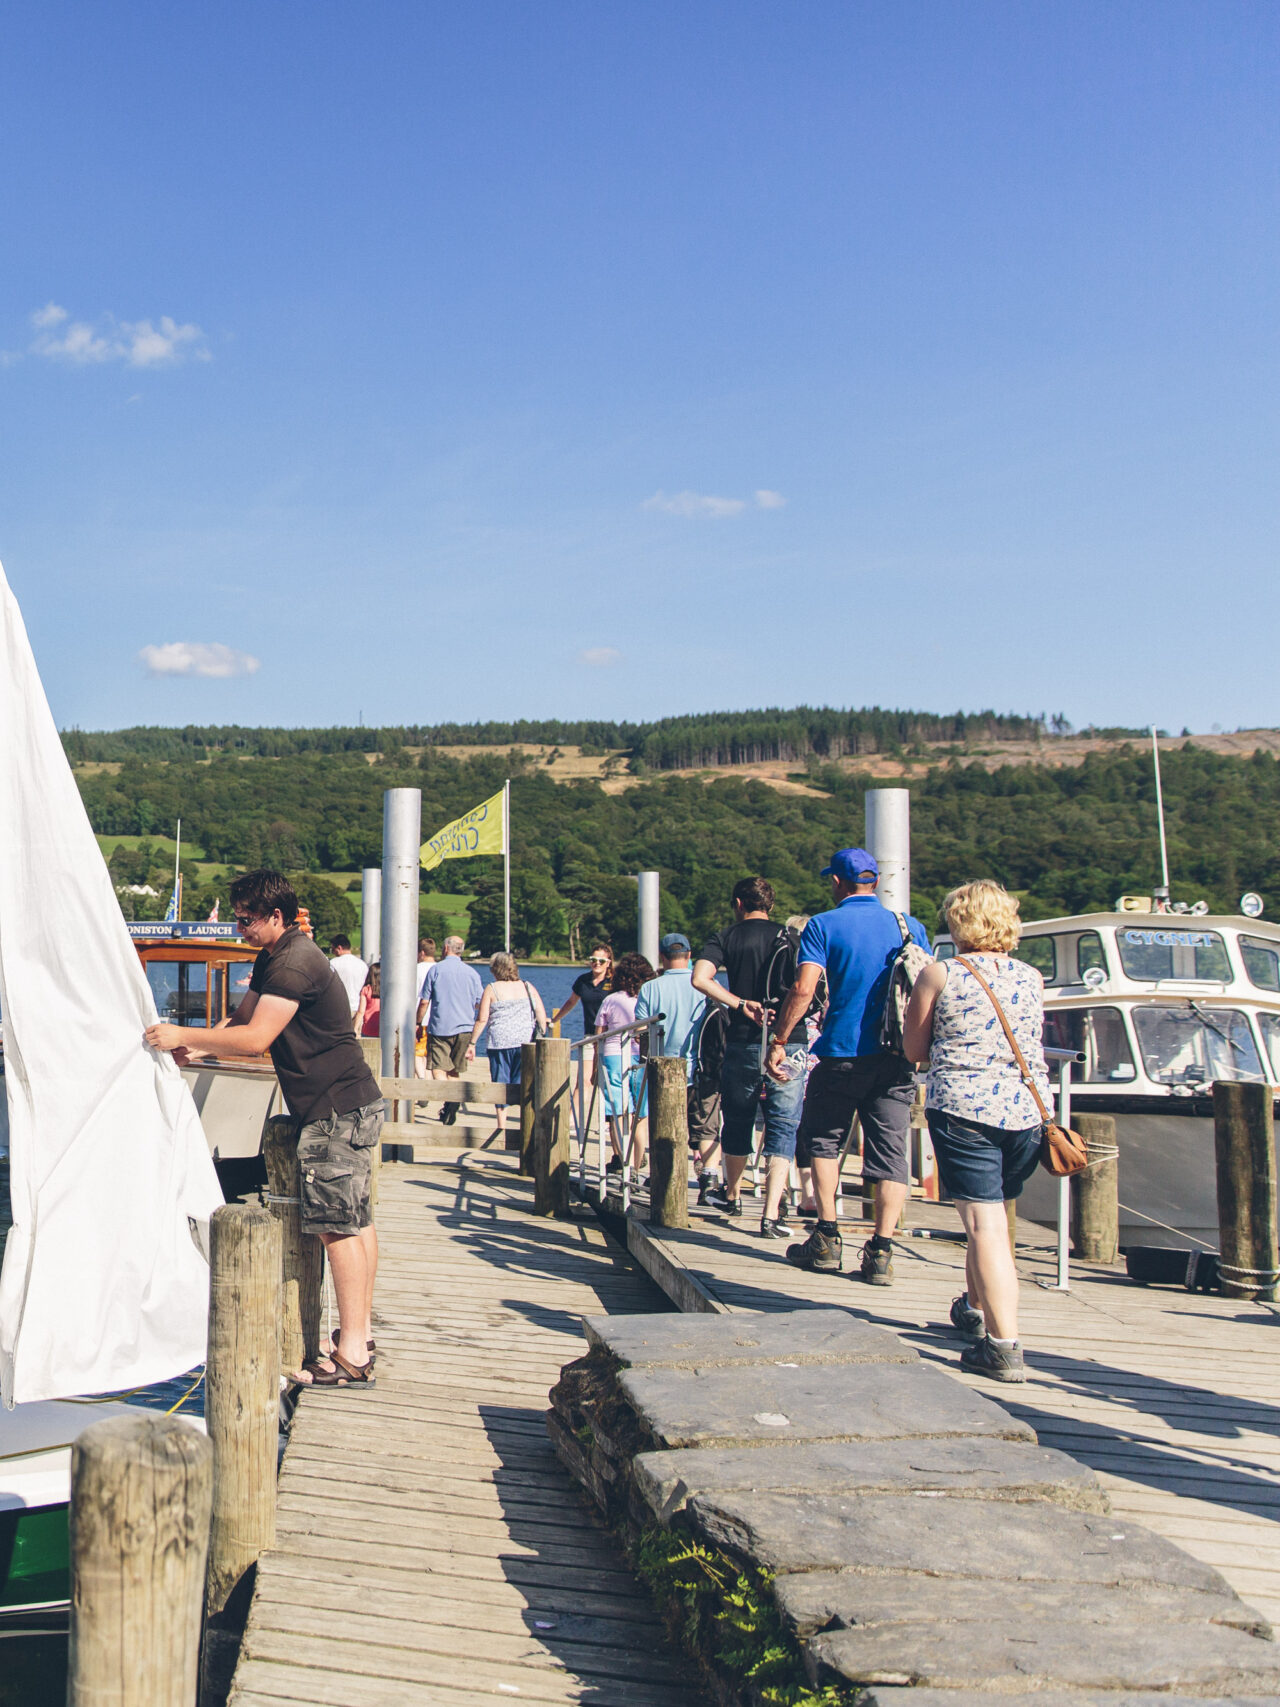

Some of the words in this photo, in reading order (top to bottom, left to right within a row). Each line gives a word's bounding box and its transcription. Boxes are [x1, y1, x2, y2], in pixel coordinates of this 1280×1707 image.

[126, 925, 173, 934] ONISTON
[188, 926, 233, 935] LAUNCH
[1125, 930, 1215, 947] CYGNET
